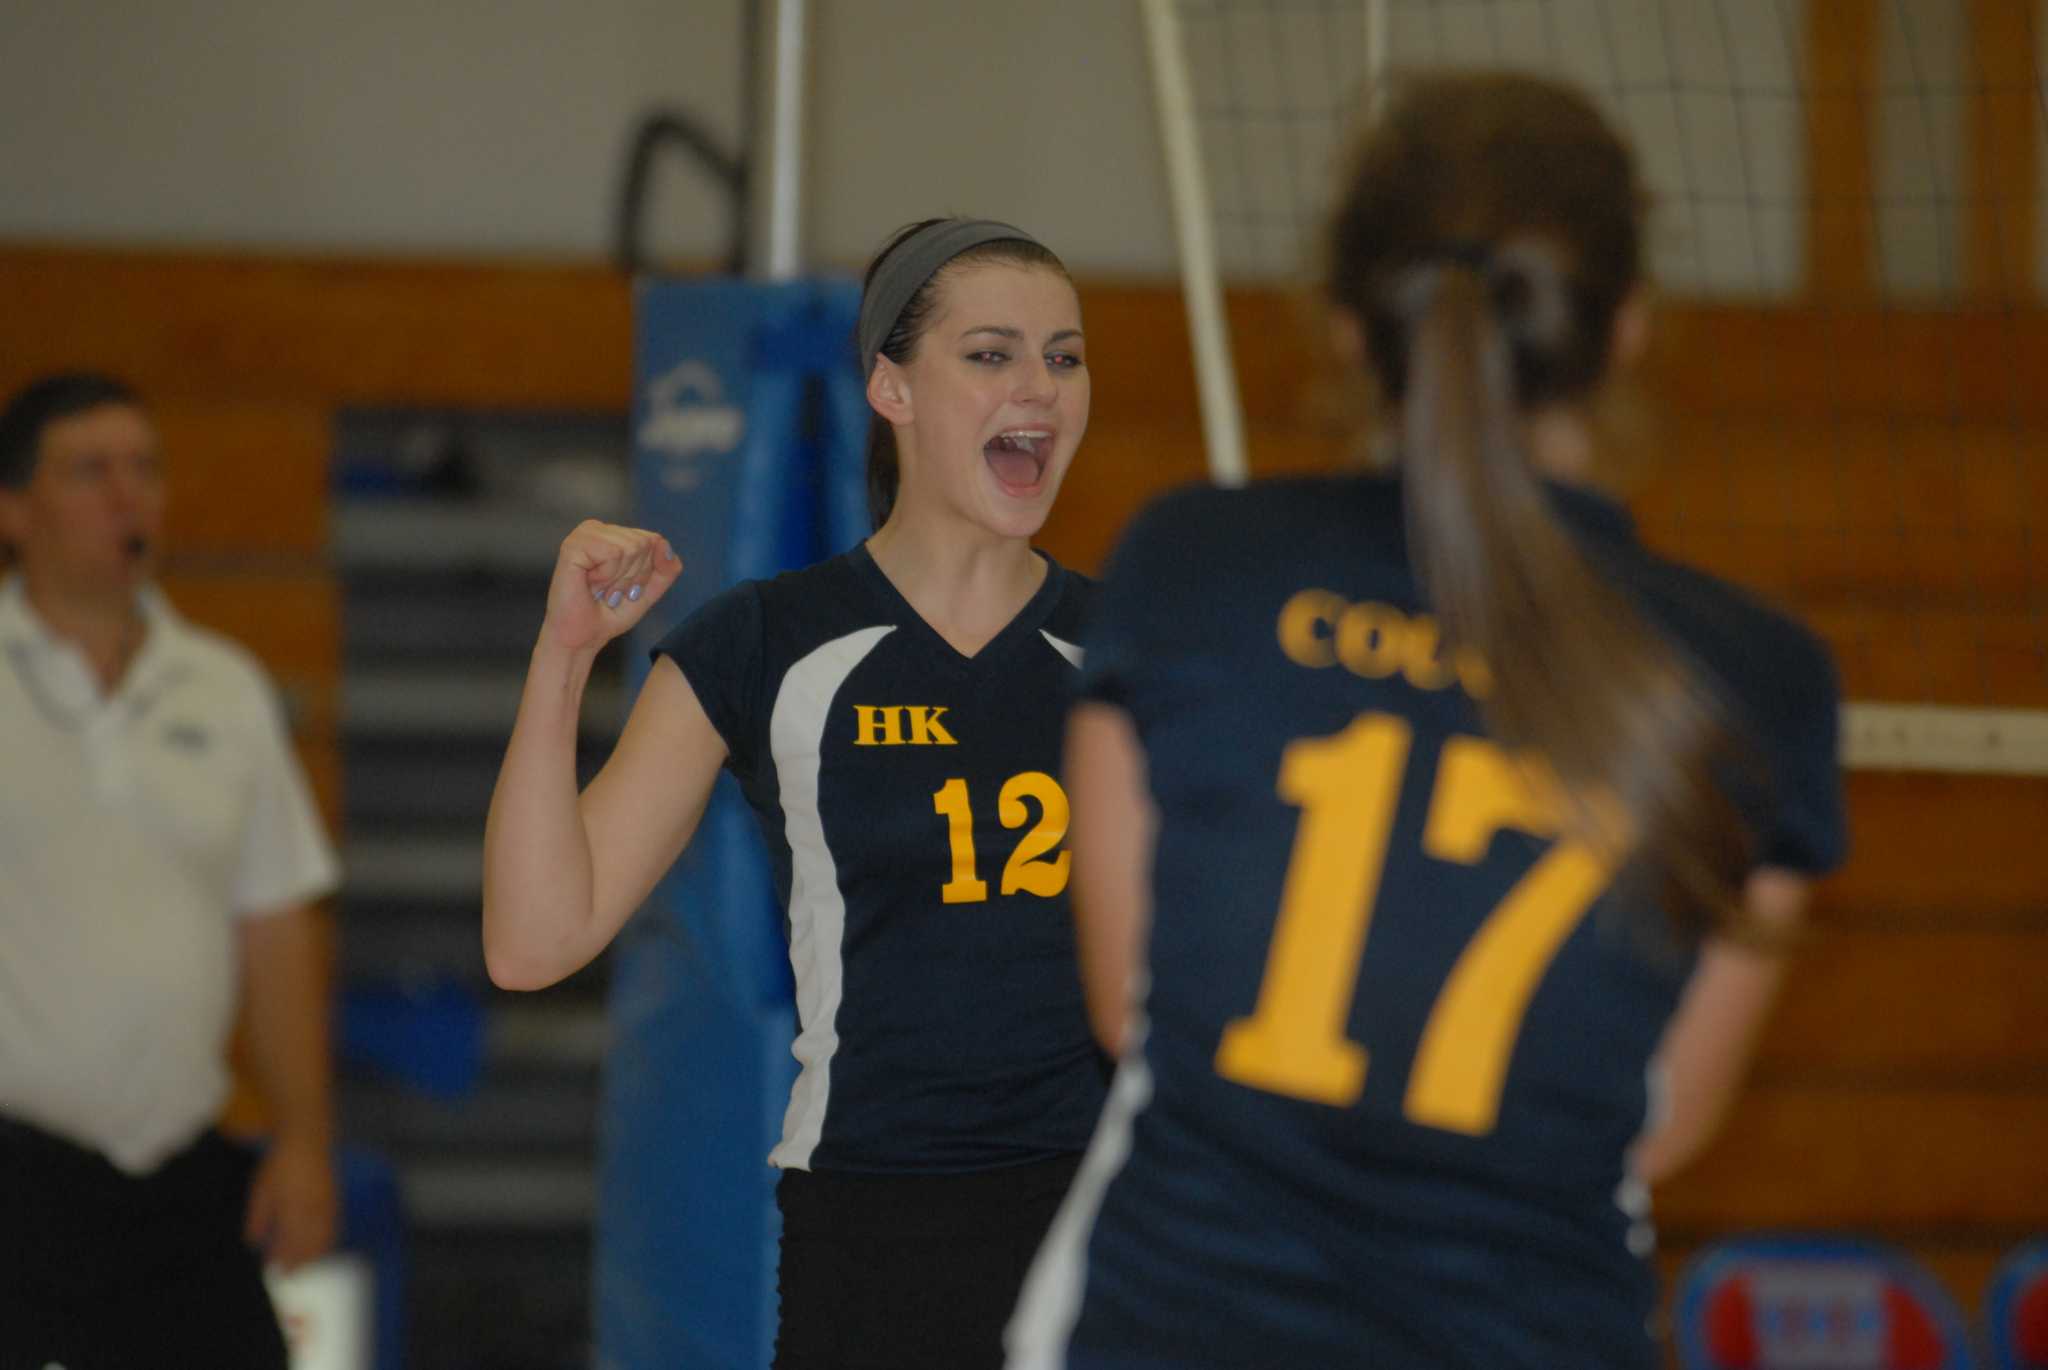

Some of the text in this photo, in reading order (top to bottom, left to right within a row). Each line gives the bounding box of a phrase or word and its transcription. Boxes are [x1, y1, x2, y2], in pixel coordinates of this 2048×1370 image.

[853, 704, 958, 746] HK
[932, 770, 1073, 904] 12
[1214, 711, 1636, 1136] 17
